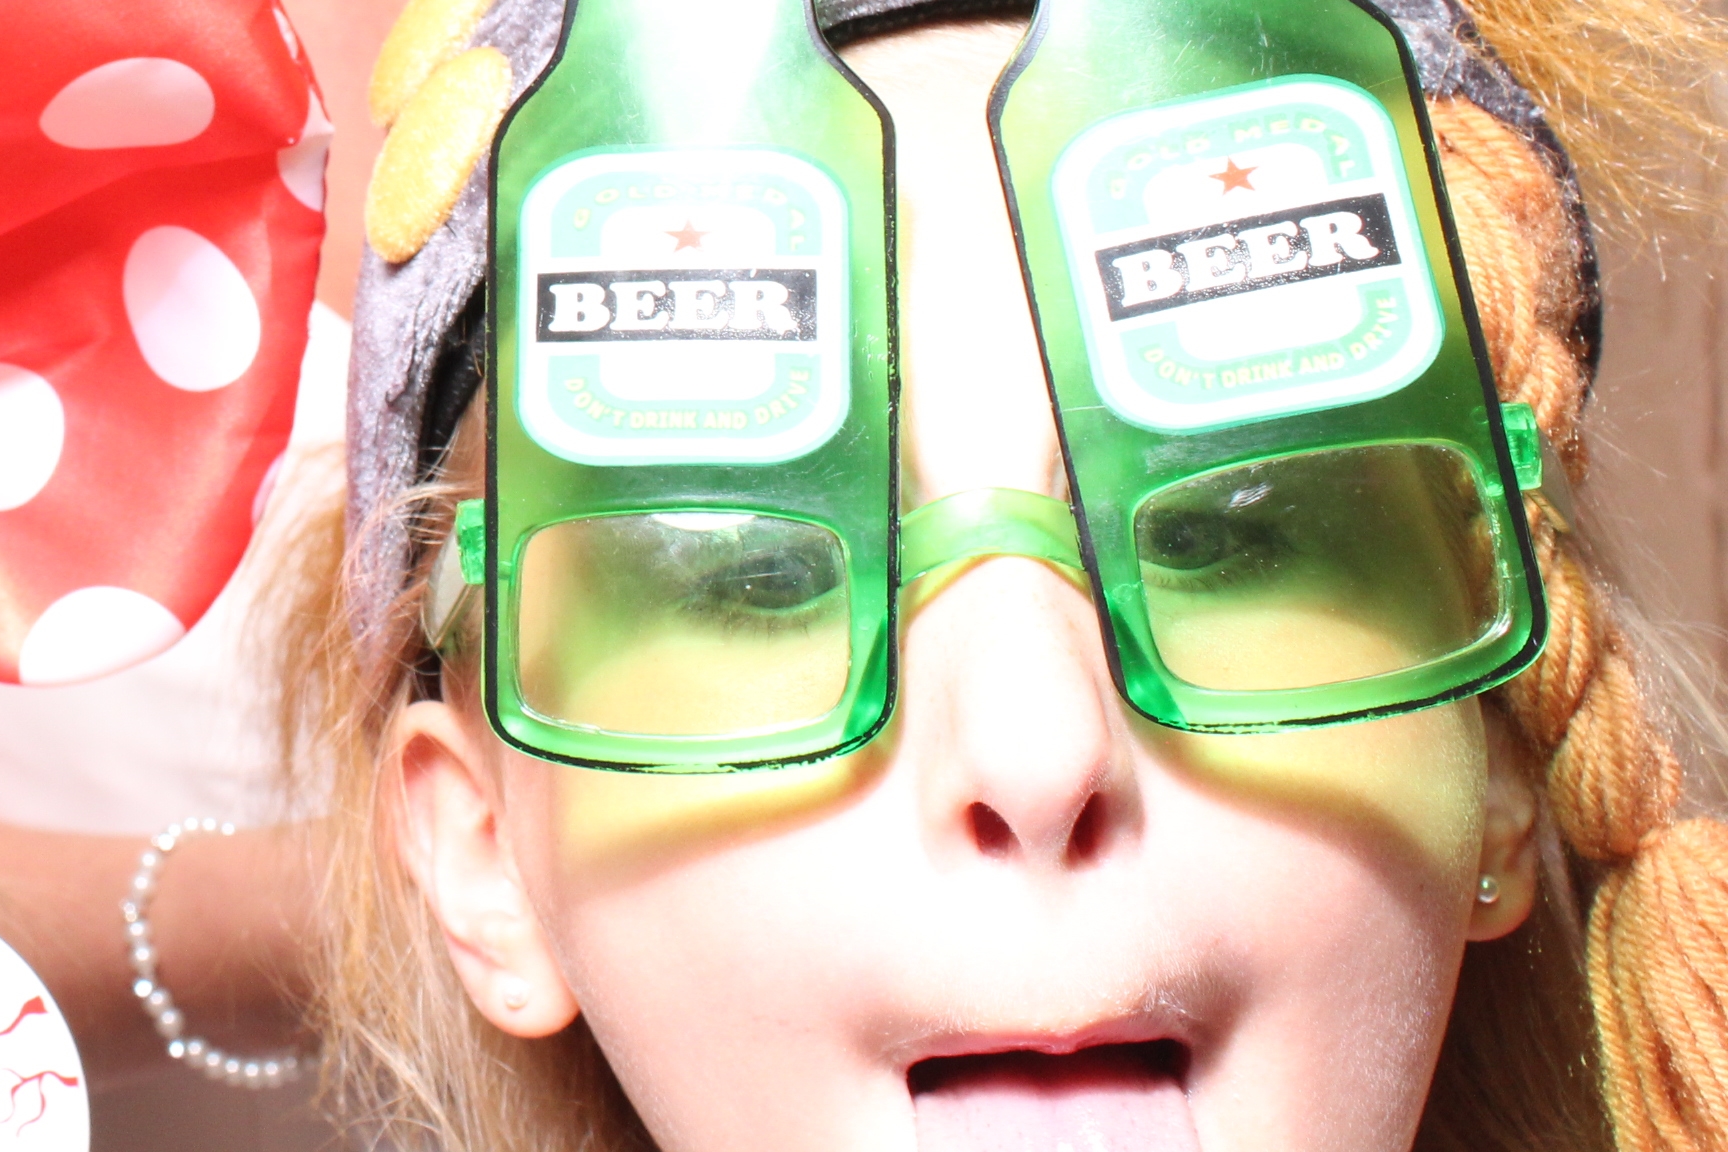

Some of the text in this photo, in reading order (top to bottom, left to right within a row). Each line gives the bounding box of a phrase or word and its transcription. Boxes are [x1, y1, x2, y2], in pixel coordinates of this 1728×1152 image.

[1232, 116, 1356, 179] MEDAL
[1110, 211, 1380, 308] BEER
[548, 280, 800, 333] BEER
[1143, 296, 1399, 390] DON'T DRINK AND DRIVE
[564, 368, 810, 430] DON'T DRINK AND DRIVE
